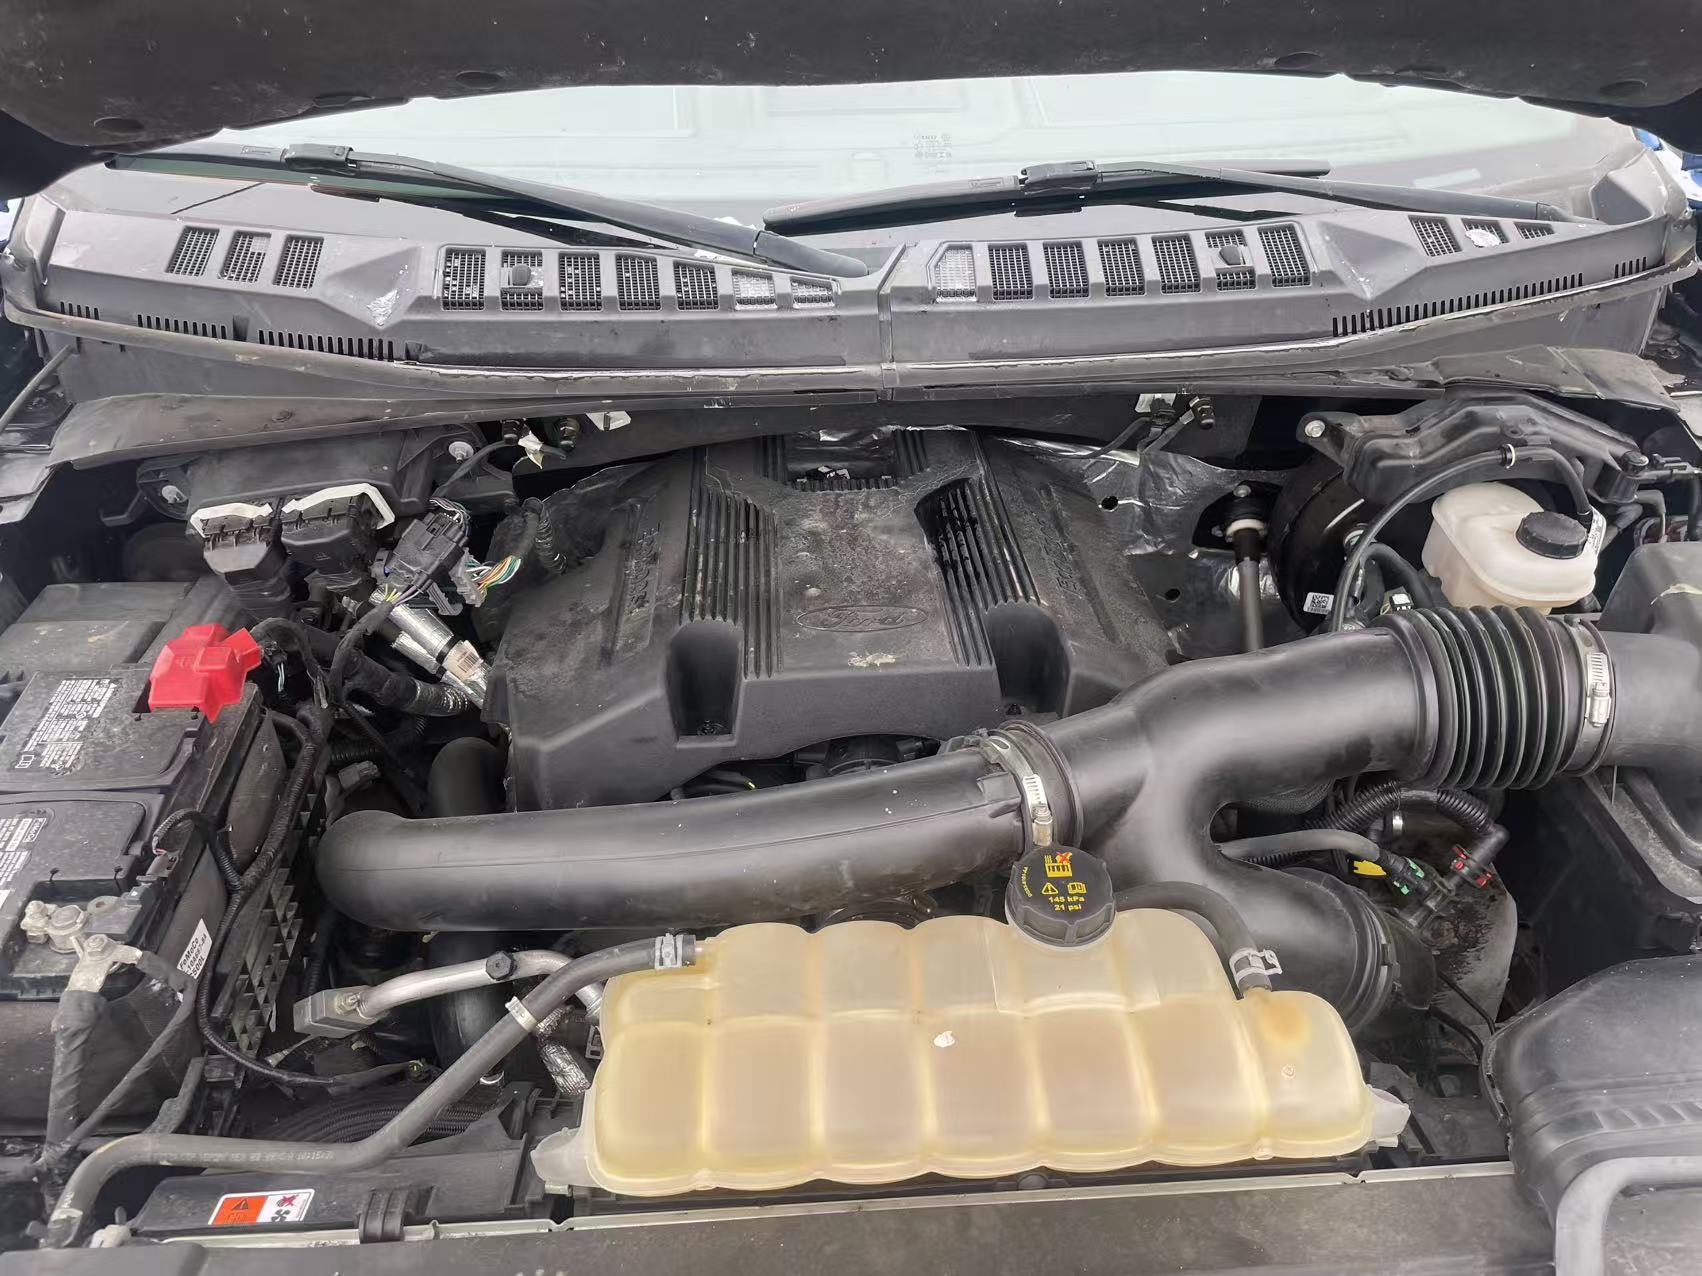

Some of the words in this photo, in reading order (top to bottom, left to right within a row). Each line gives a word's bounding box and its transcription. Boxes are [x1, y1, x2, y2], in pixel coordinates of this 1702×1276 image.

[822, 607, 906, 629] Ford
[1068, 904, 1082, 912] psi
[180, 937, 199, 970] FoMoCo
